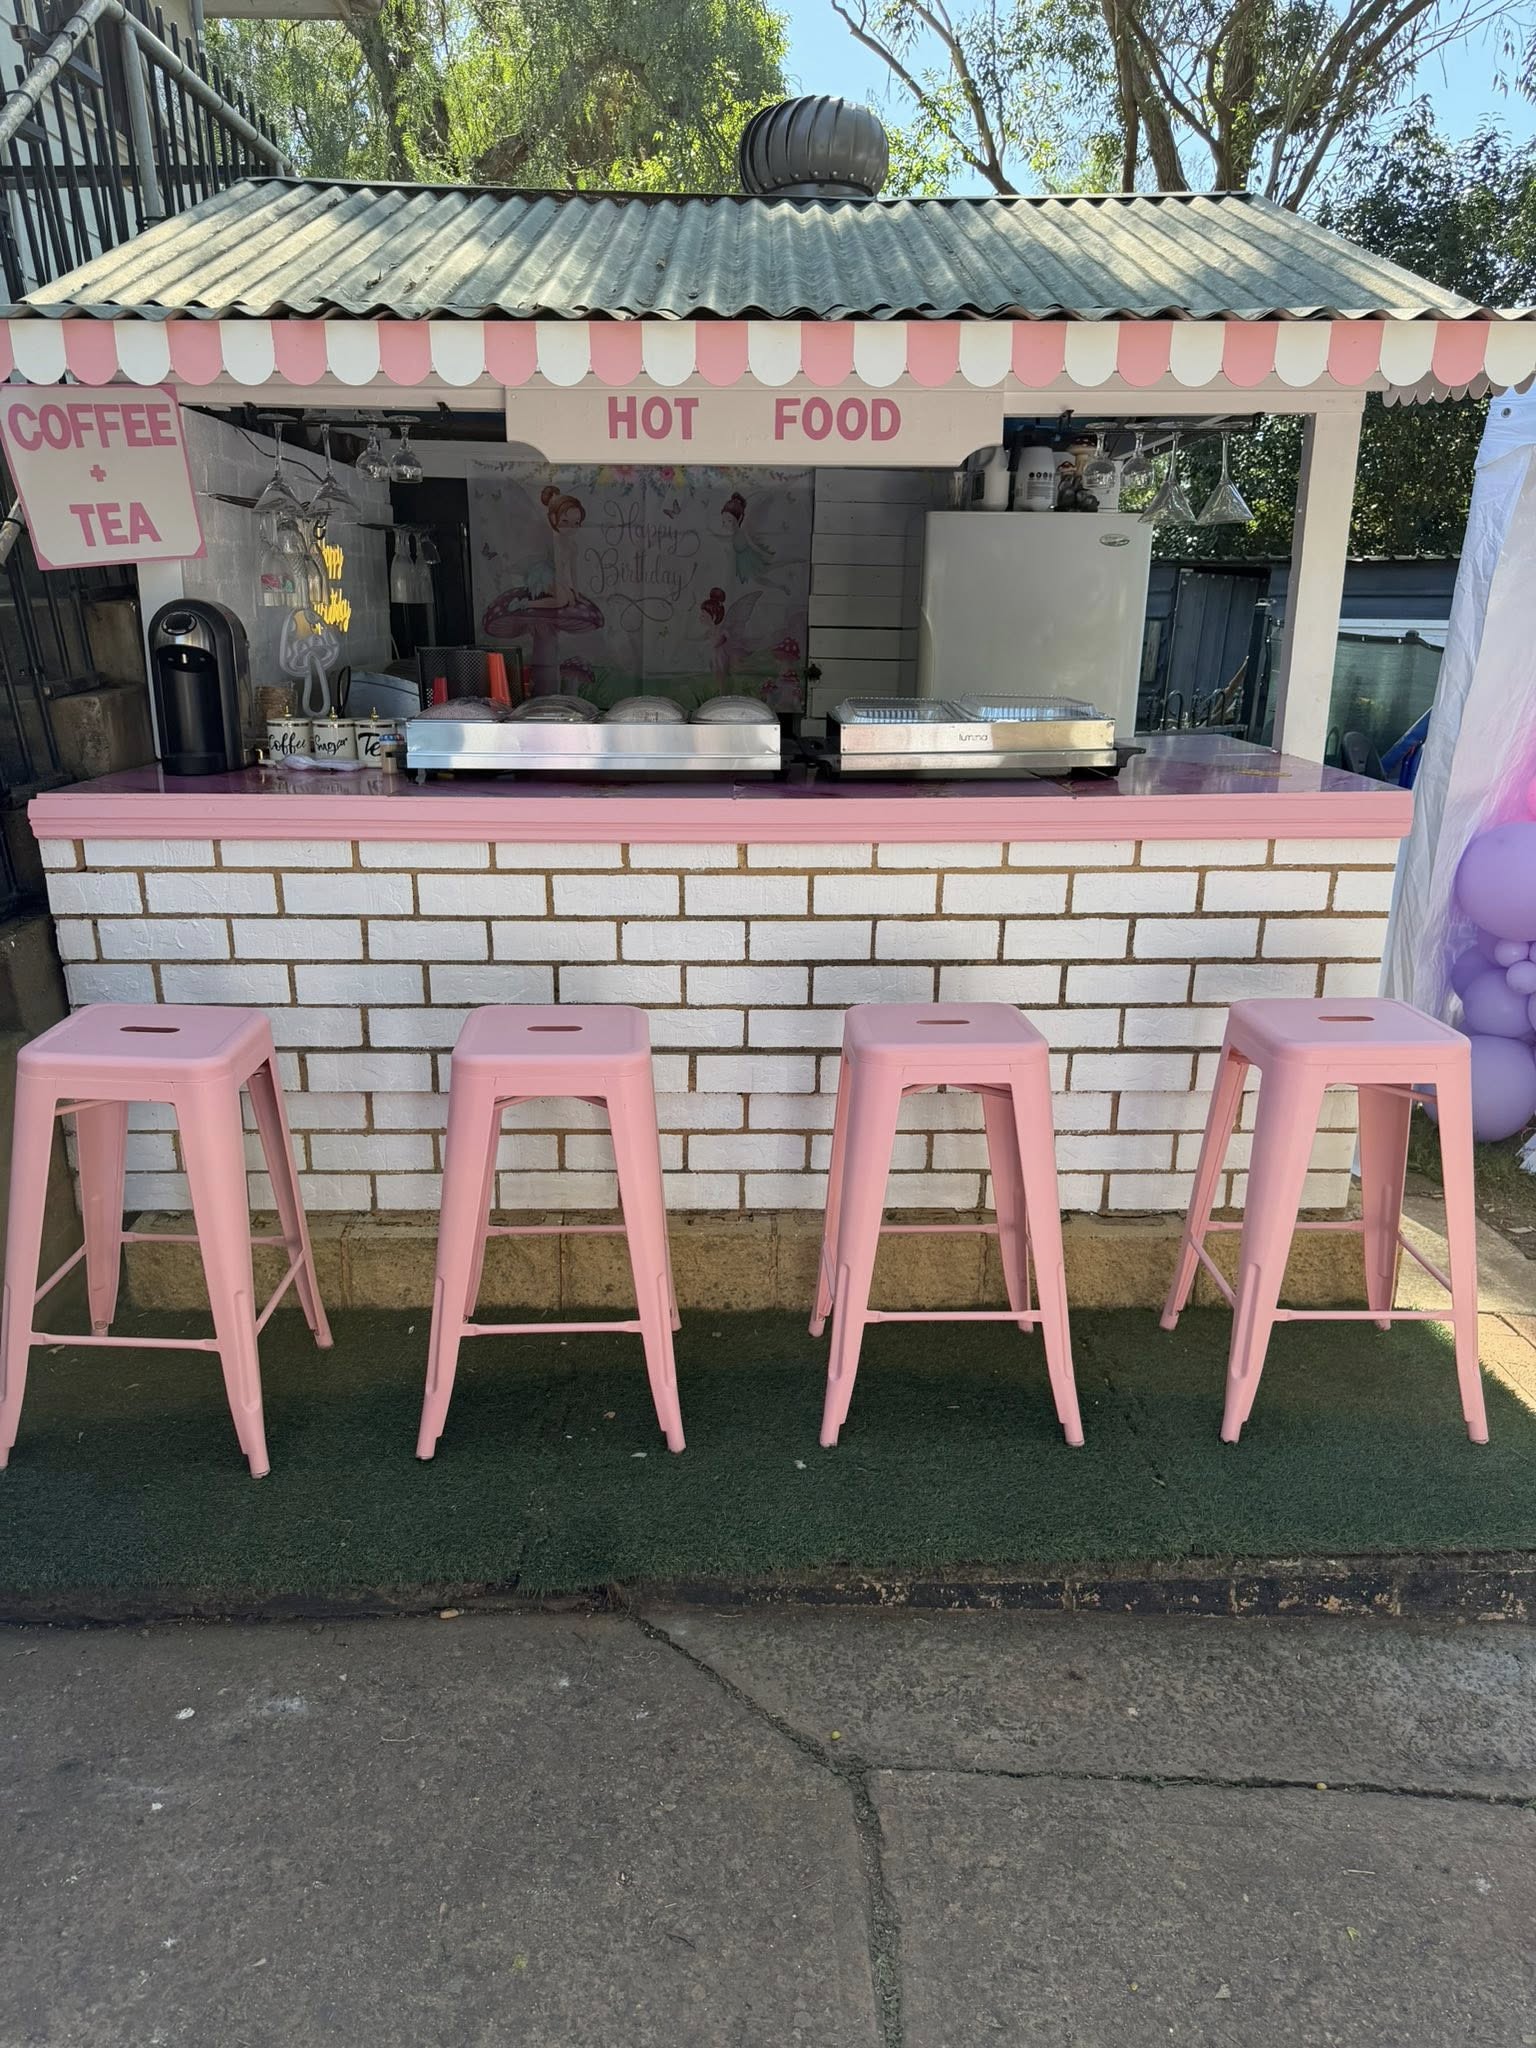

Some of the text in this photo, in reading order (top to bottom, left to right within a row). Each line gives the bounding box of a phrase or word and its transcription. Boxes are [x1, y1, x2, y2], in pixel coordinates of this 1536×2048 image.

[8, 403, 178, 451] COFFEE
[607, 396, 902, 441] HOT FOOD
[90, 464, 107, 482] +
[69, 502, 162, 547] TEA
[603, 500, 701, 558] Happy
[584, 547, 698, 602] Birthday
[314, 734, 348, 756] Sugar
[358, 732, 382, 757] Te
